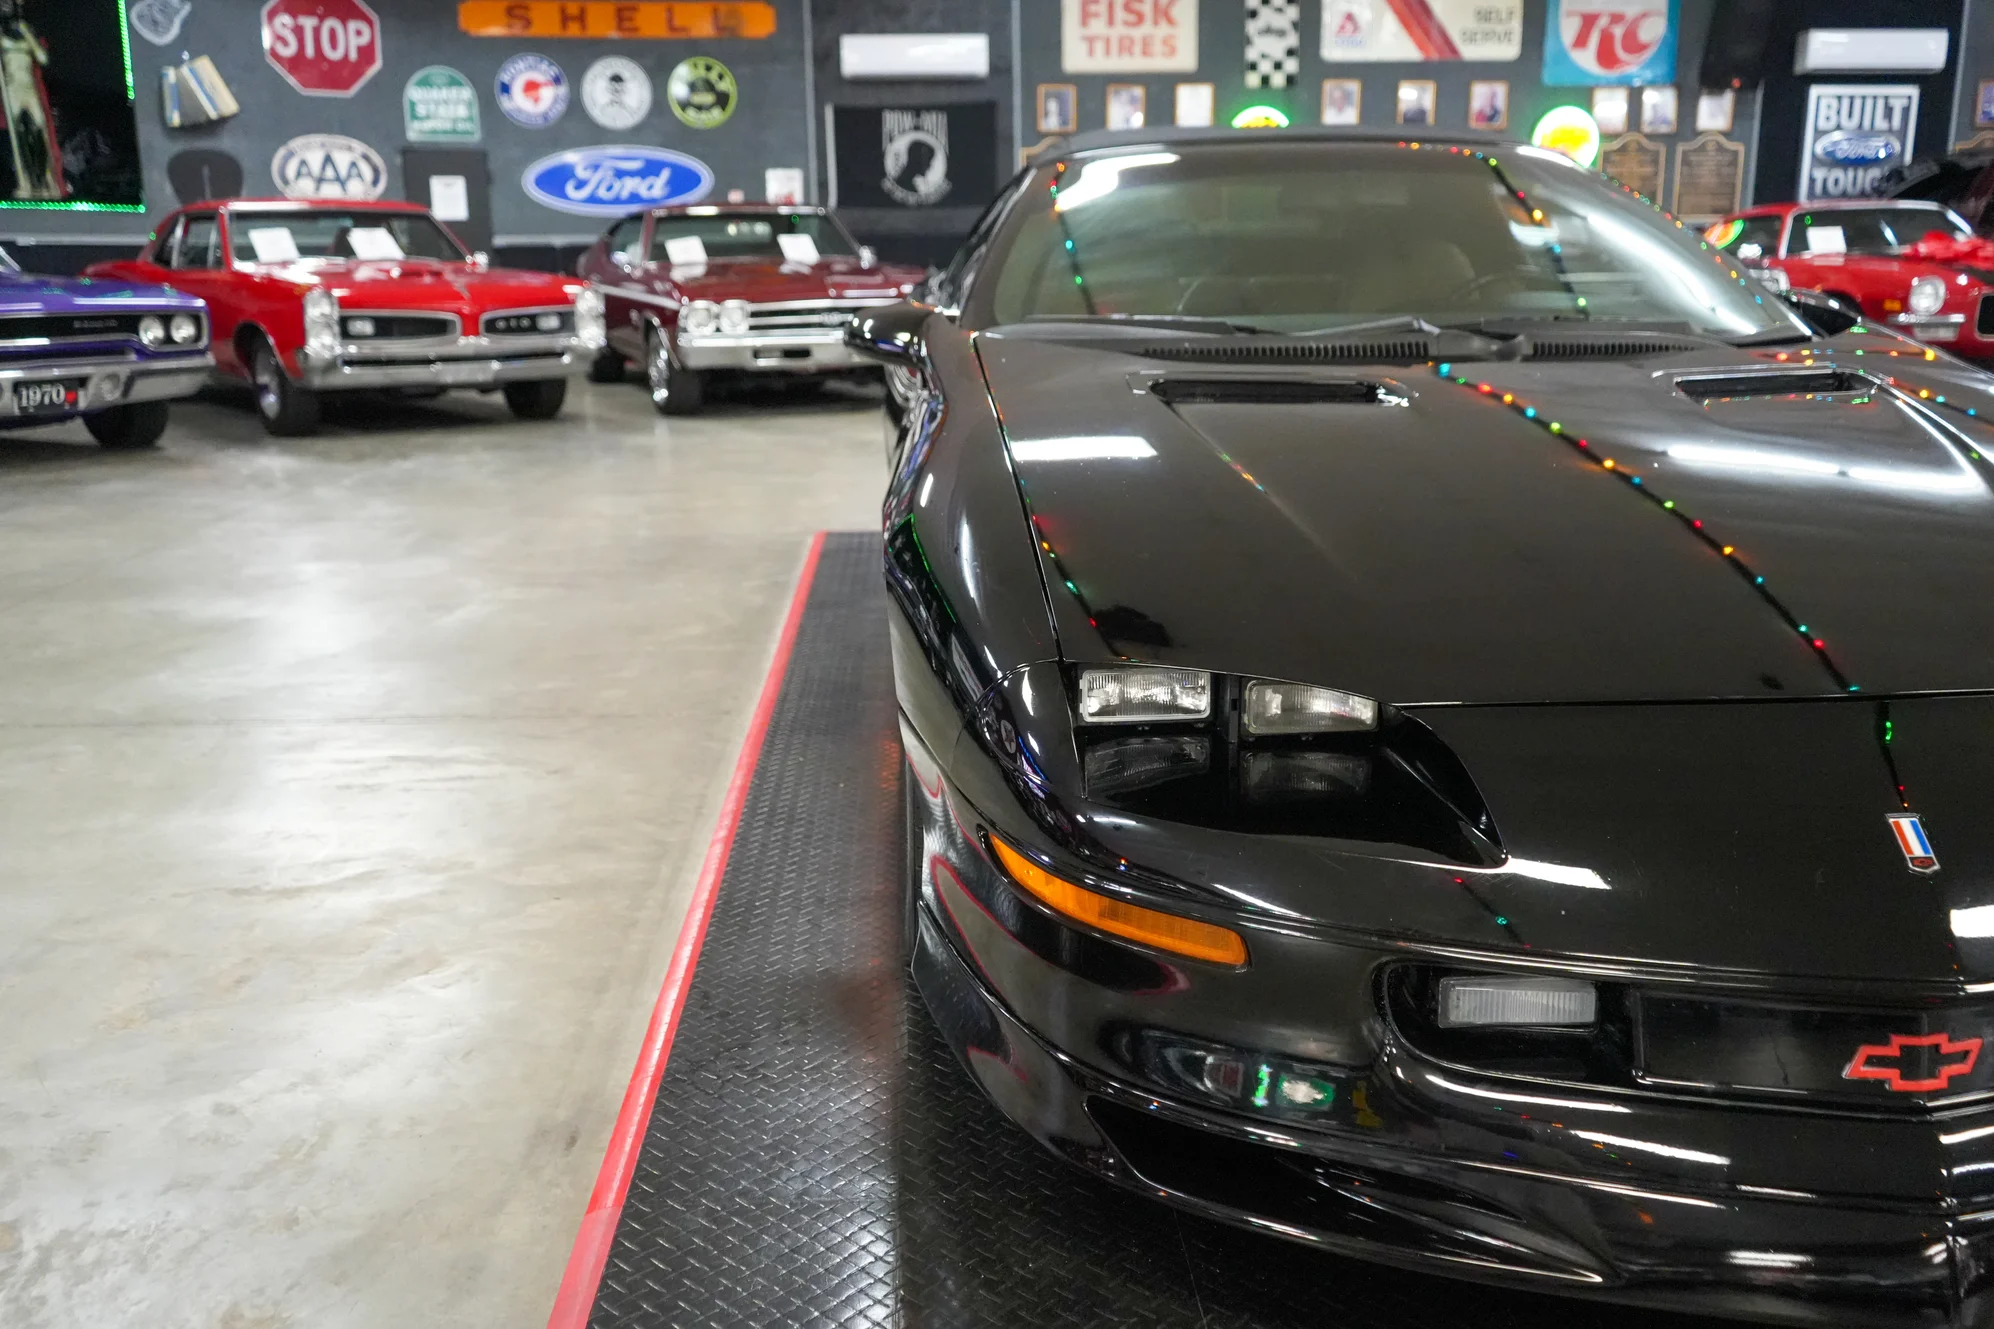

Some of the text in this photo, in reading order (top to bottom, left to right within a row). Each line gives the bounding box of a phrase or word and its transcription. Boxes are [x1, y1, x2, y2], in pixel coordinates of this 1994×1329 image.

[504, 3, 737, 34] SHELL
[1079, 0, 1178, 28] FISK
[273, 12, 372, 62] STOP
[1080, 33, 1178, 58] TIRES
[1816, 96, 1910, 132] BUILT
[295, 152, 364, 193] AAA
[564, 157, 672, 201] Ford
[1811, 166, 1889, 197] TOUG
[19, 382, 66, 407] 1970
